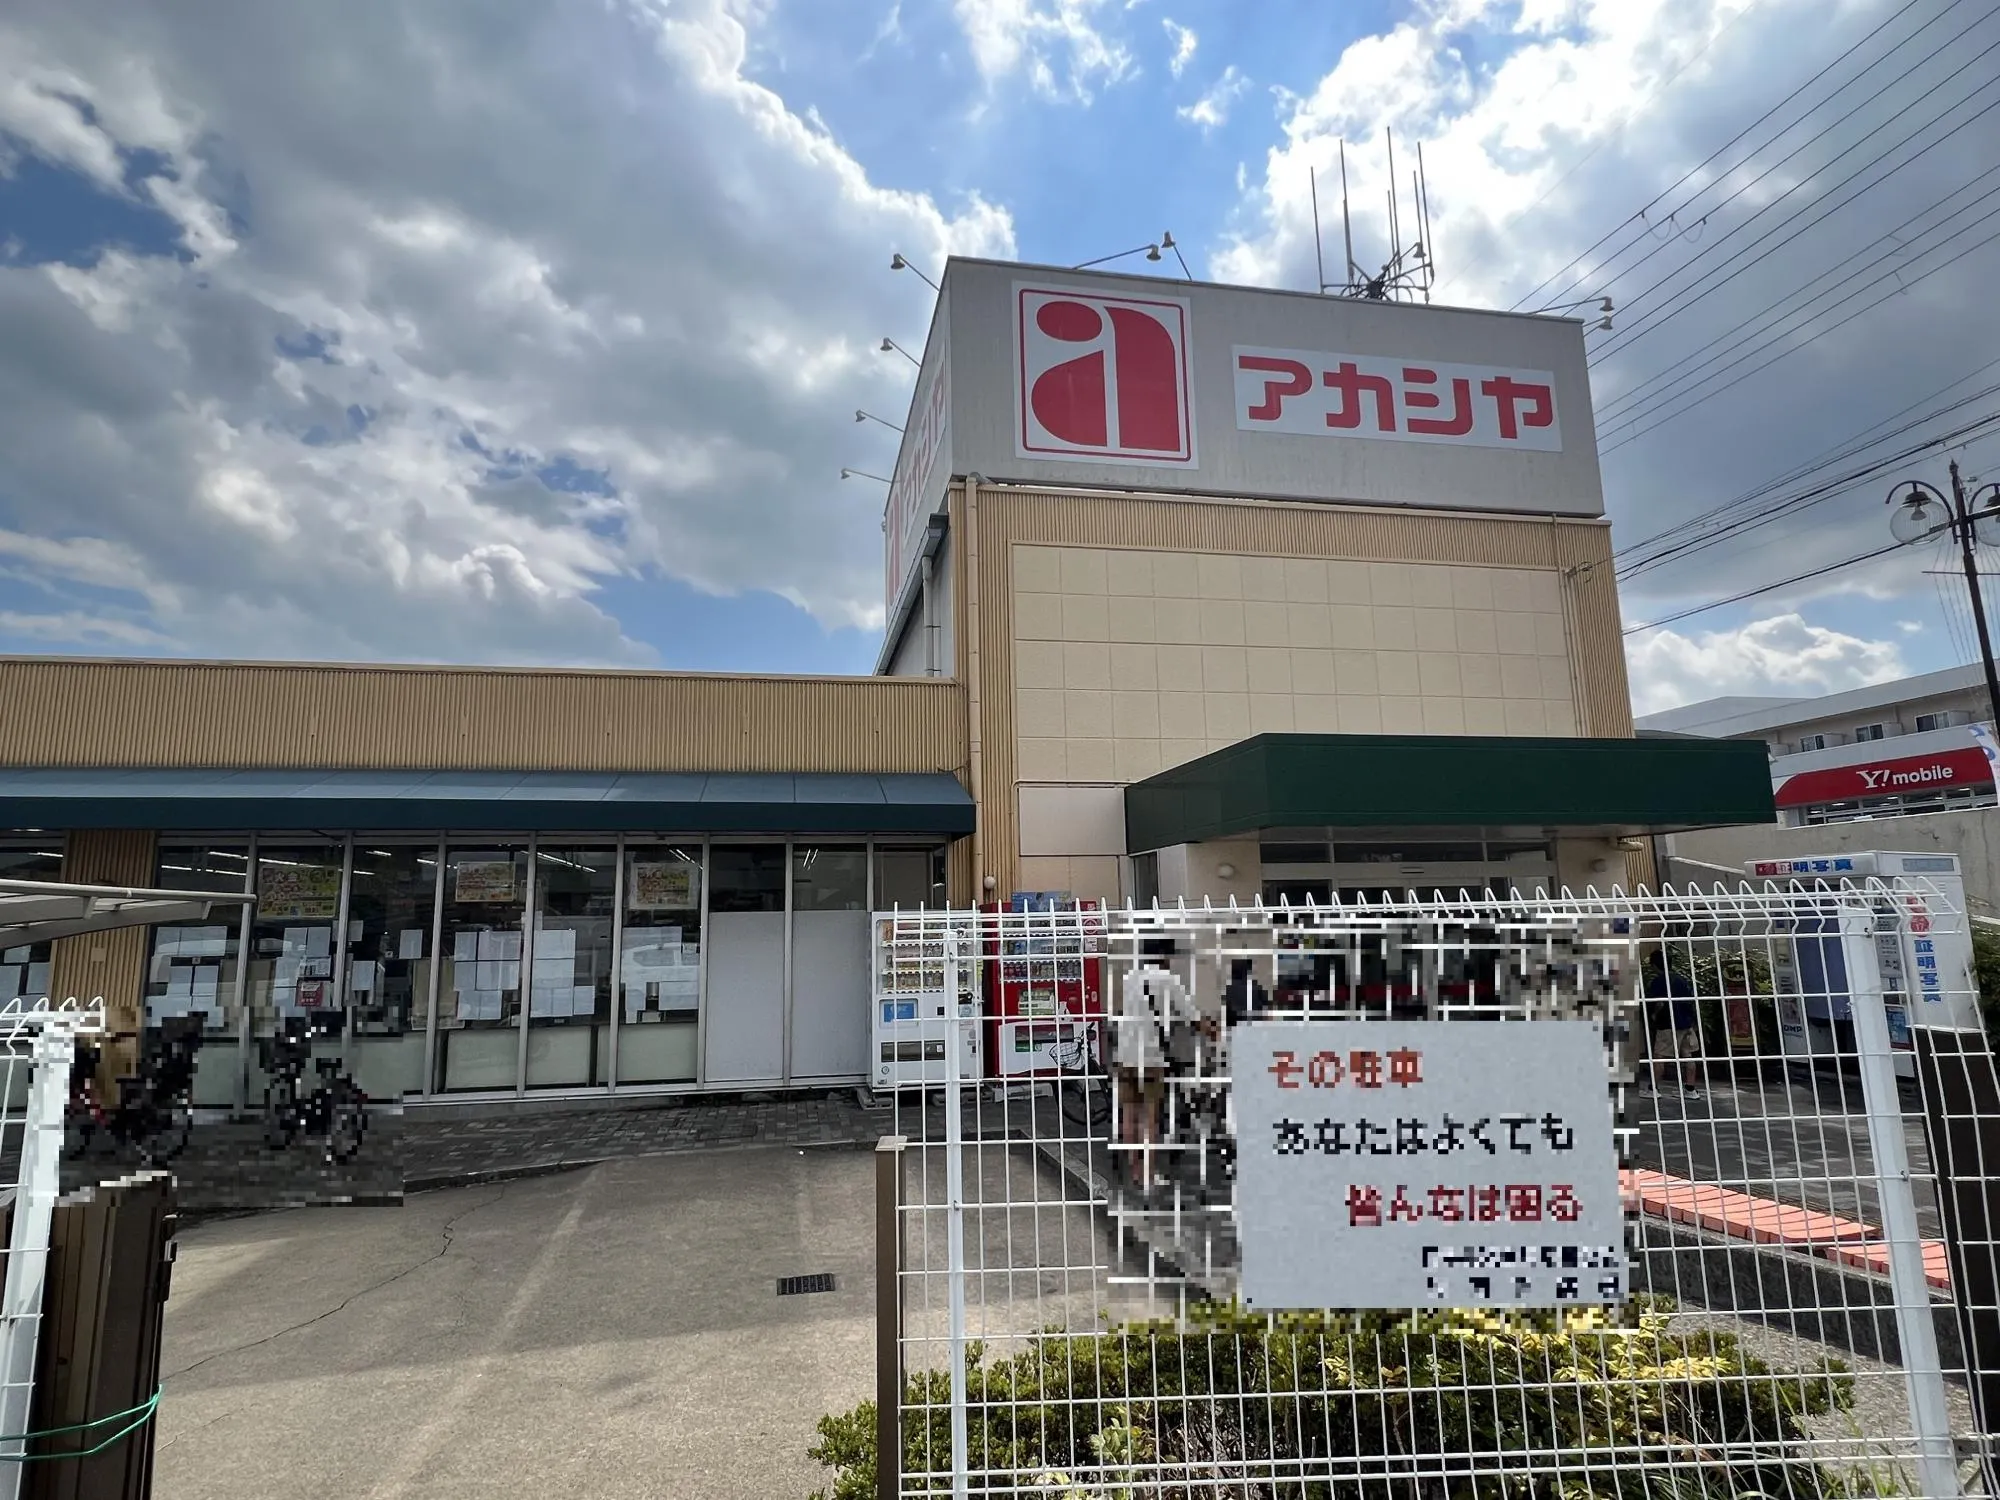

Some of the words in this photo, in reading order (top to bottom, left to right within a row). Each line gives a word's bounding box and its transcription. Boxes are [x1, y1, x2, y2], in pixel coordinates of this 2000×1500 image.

[1238, 355, 1553, 440] アカシヤ
[1268, 1046, 1423, 1089] その駐車
[1272, 1112, 1574, 1155] あなたはよくても
